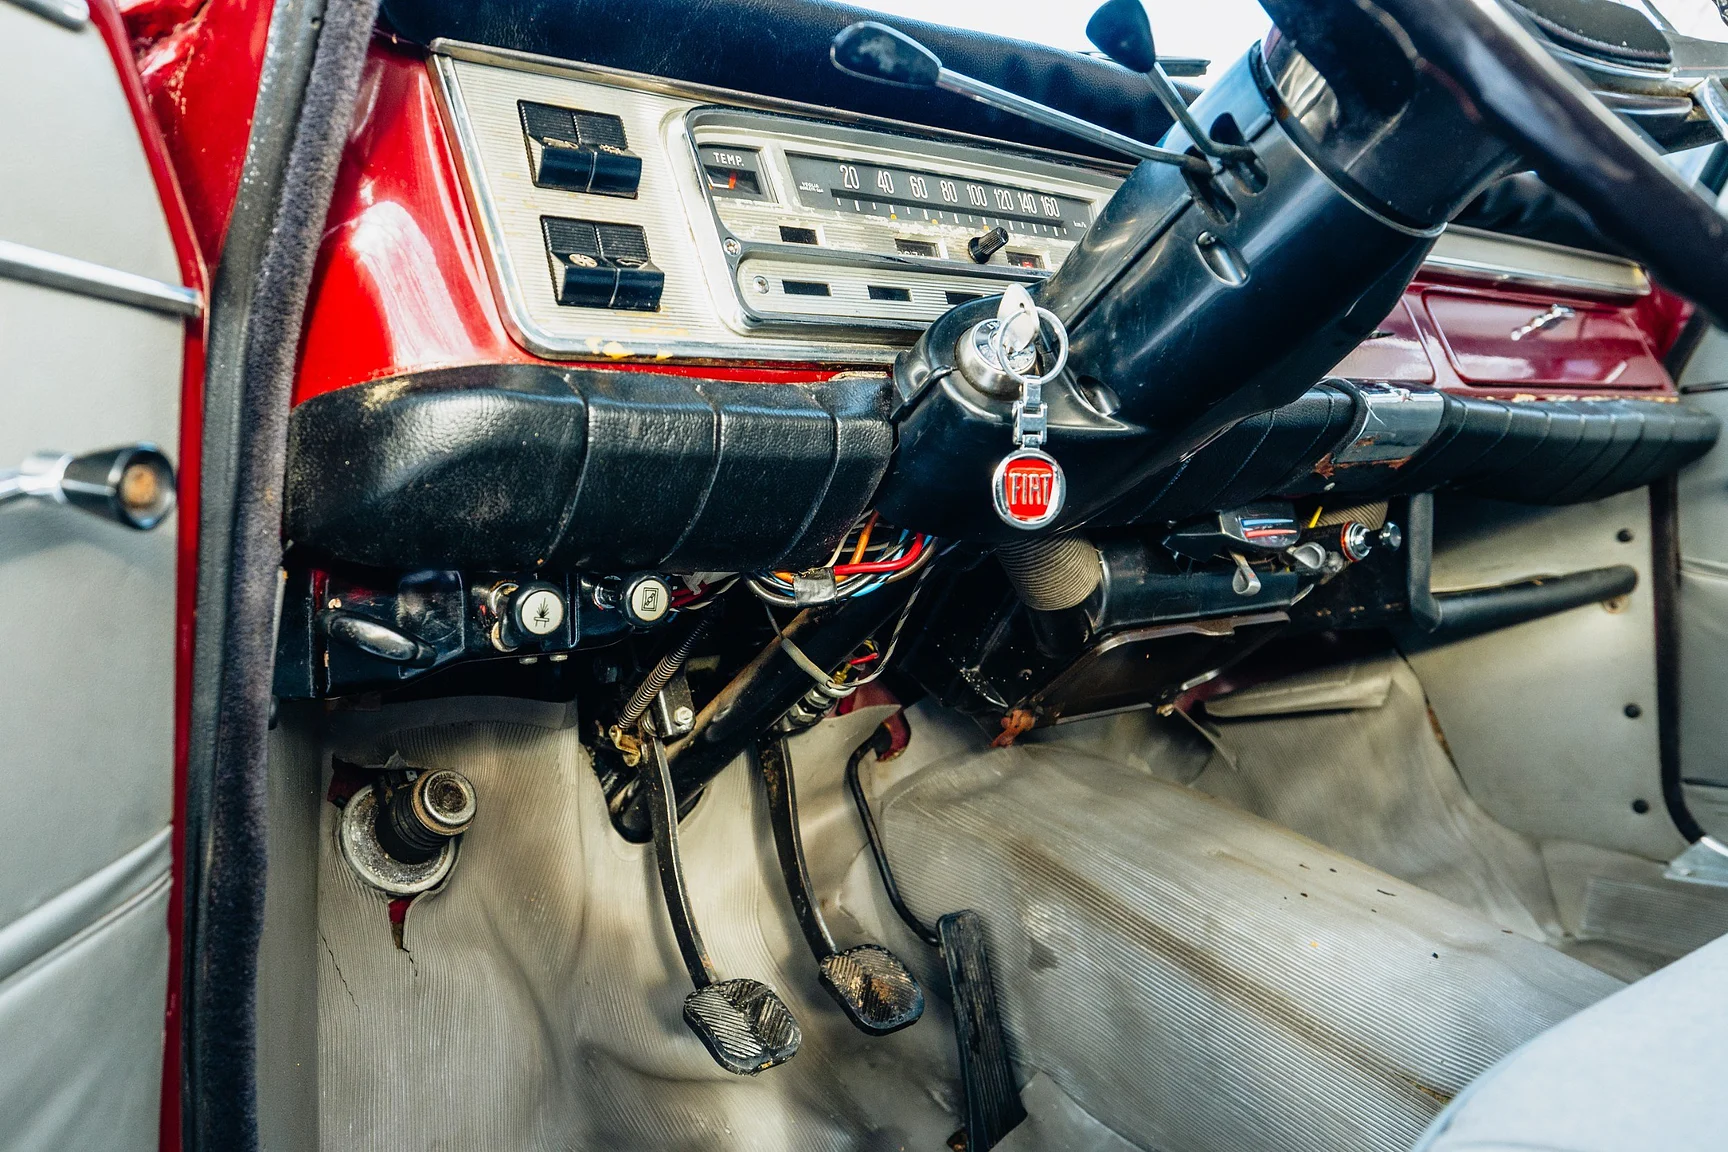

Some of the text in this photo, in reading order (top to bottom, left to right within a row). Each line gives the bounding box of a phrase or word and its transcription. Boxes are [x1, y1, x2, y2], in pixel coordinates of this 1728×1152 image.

[713, 152, 745, 167] TEMP.
[839, 164, 1061, 218] 20 40 60 80 100 120 140 160
[1008, 472, 1053, 506] FIAT
